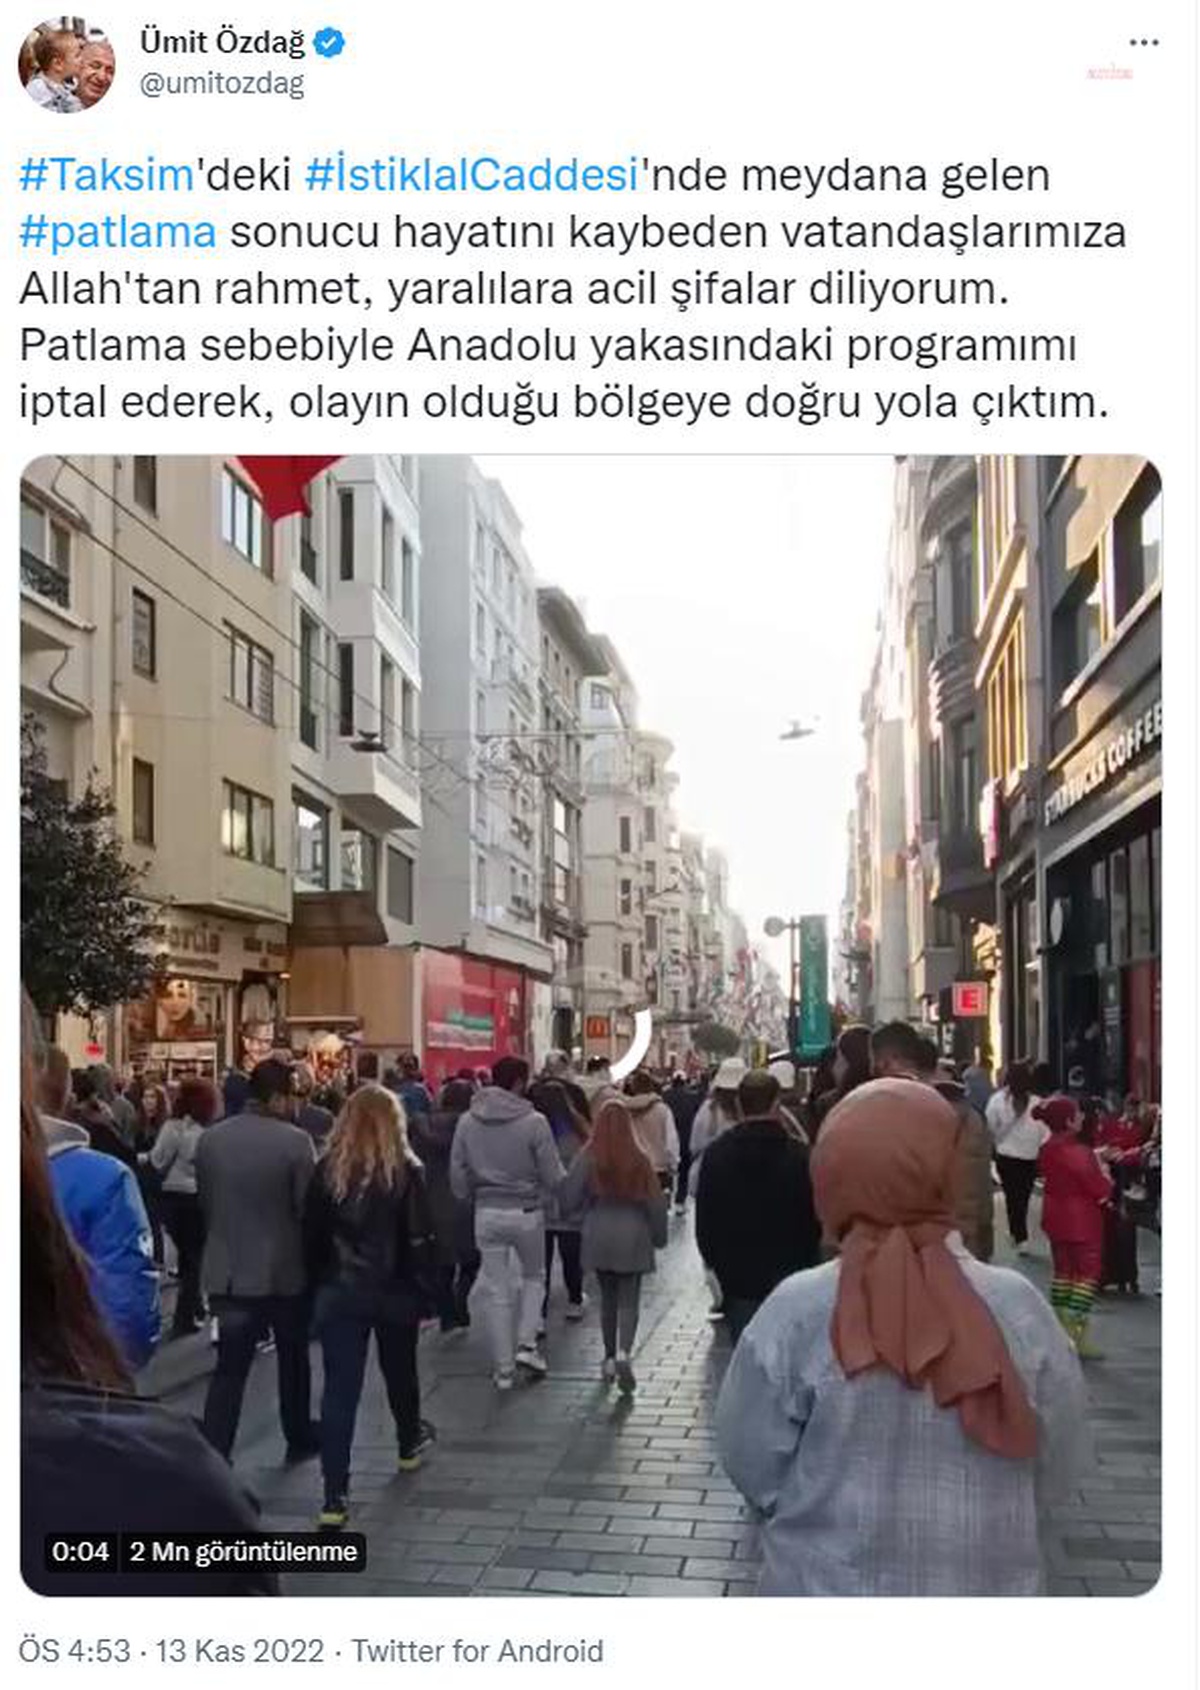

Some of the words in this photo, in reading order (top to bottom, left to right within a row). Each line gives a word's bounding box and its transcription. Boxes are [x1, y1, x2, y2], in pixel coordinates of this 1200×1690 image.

[140, 23, 209, 54] Ümit
[215, 23, 307, 60] Özdağ
[140, 70, 305, 101] @umitozdag
[19, 155, 291, 192] #Taksim'deki
[304, 149, 728, 192] #İstiklalCaddesi'nde
[742, 156, 927, 200] meydana
[941, 156, 1050, 200] gelen
[18, 213, 216, 256] #patlama
[230, 221, 379, 248] sonucu
[395, 213, 554, 257] hayatını
[569, 213, 767, 256] kaybeden
[780, 213, 1127, 257] vatandaşlarımıza
[18, 270, 201, 305] Allah'tan
[215, 270, 373, 311] rahmet,
[387, 270, 573, 313] yaralılara
[587, 268, 656, 305] acil
[670, 268, 797, 313] şifalar
[809, 268, 1008, 313] diliyorum.
[21, 326, 186, 362] Patlama
[200, 325, 394, 370] sebebiyle
[406, 326, 576, 362] Anadolu
[589, 325, 833, 370] yakasındaki
[848, 332, 1076, 370] programımı
[20, 382, 106, 426] iptal
[121, 383, 274, 424] ederek,
[289, 383, 409, 427] olayın
[423, 381, 559, 427] olduğu
[574, 382, 732, 427] bölgeye
[745, 380, 860, 427] doğru
[873, 383, 958, 426] yola
[972, 383, 1108, 427] çıktım.
[1106, 700, 1162, 773] COFFEE
[18, 1633, 60, 1663] ÖS
[67, 1638, 131, 1663] 4:53
[156, 1638, 187, 1663] 13
[195, 1638, 246, 1663] Kas
[253, 1638, 324, 1663] 2022
[350, 1638, 446, 1663] Twitter
[451, 1638, 491, 1663] for
[497, 1638, 604, 1663] Android
